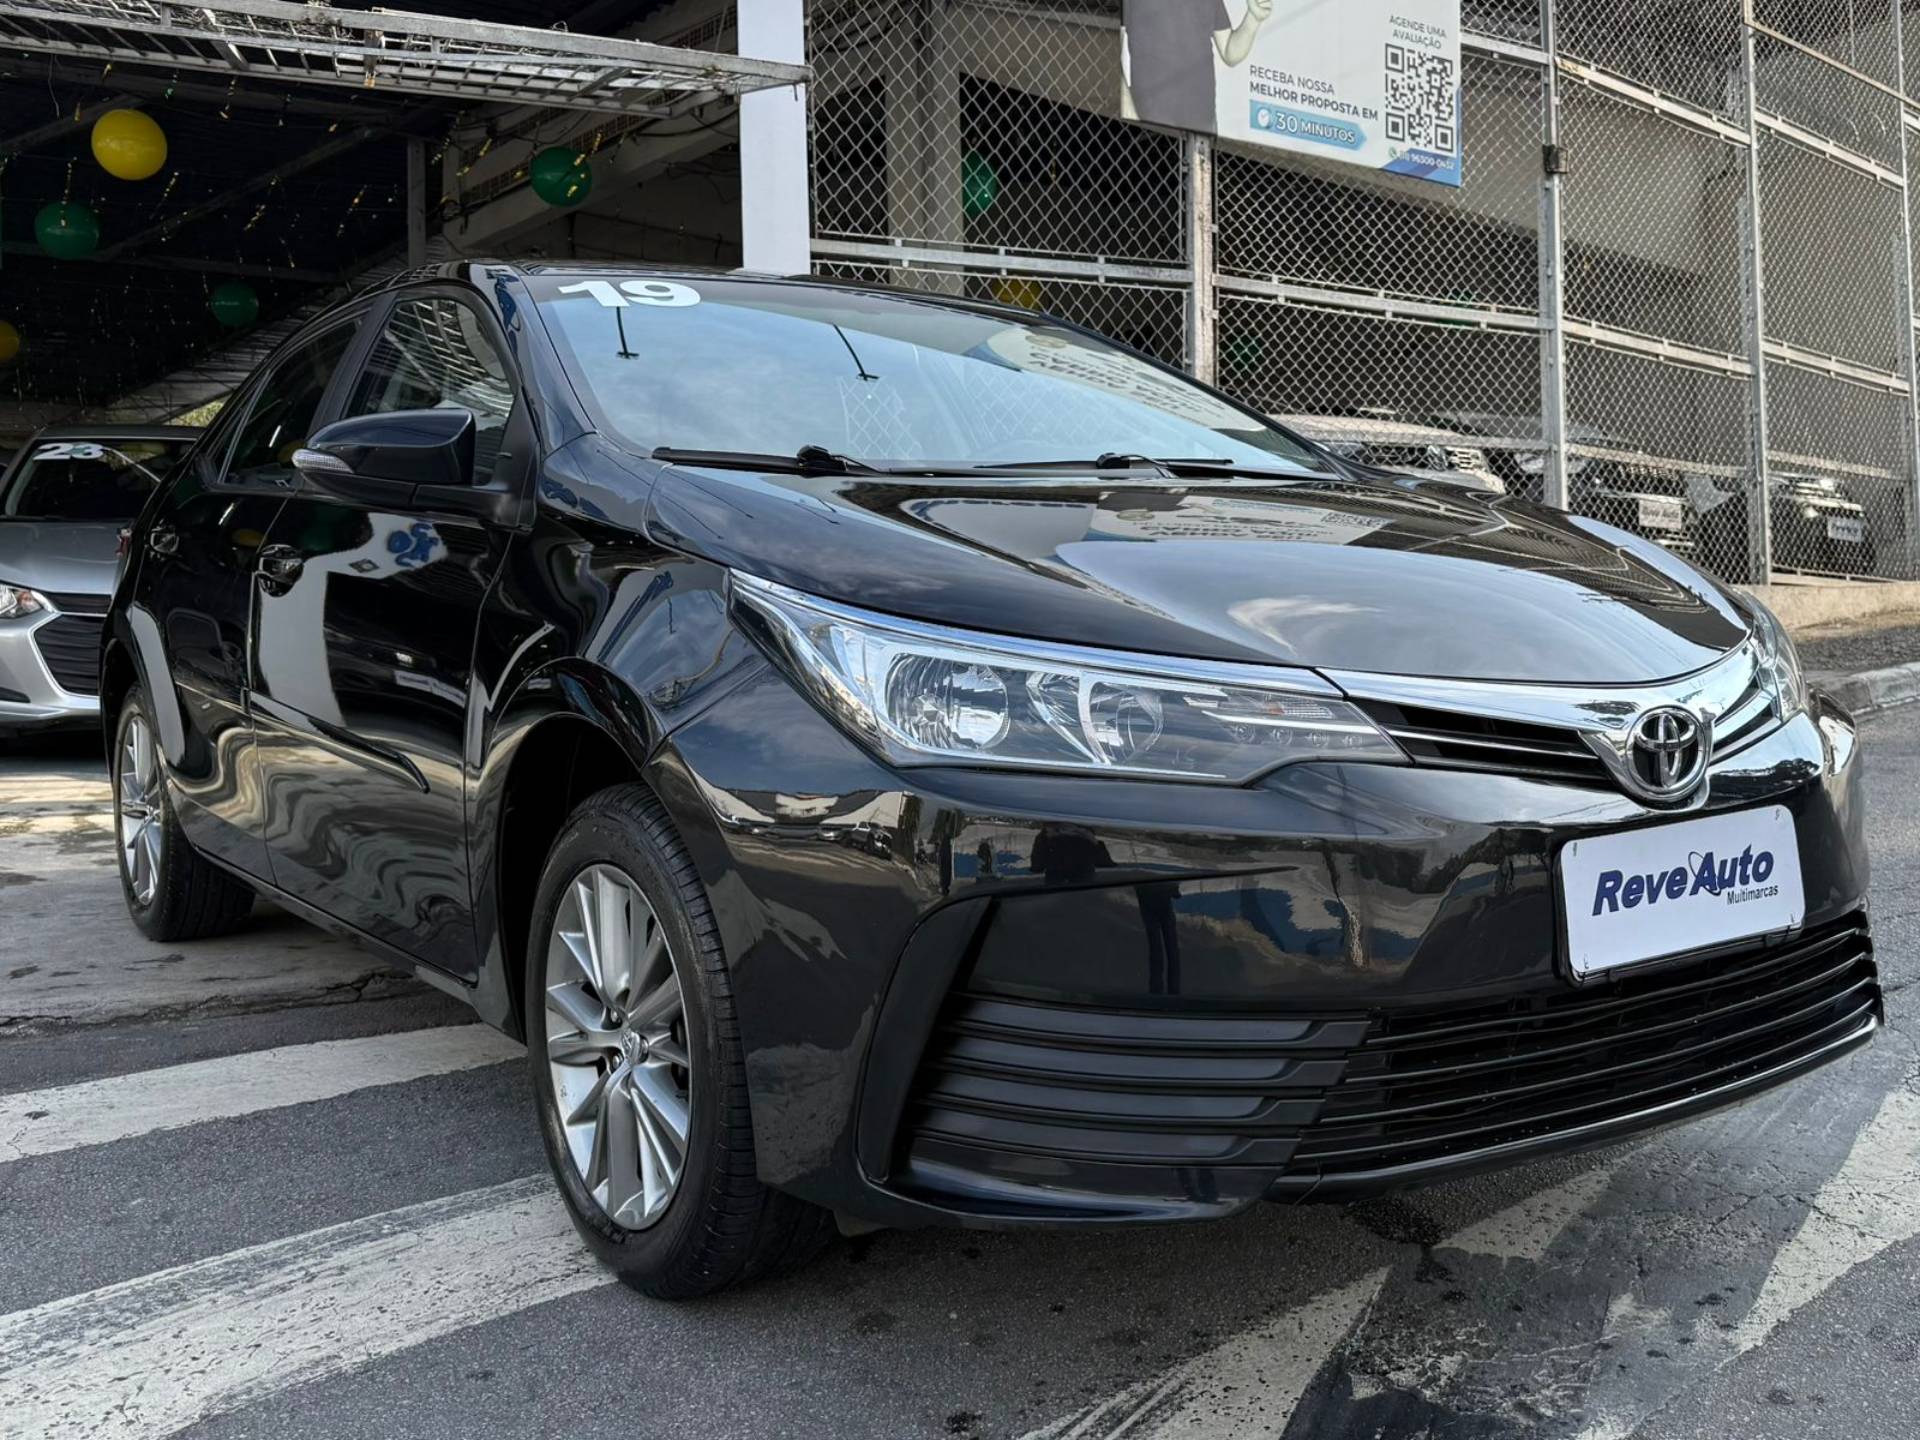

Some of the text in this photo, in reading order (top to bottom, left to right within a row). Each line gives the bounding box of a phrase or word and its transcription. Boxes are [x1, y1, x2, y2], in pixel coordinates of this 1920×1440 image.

[1389, 15, 1447, 39] AGENDE UMA
[1393, 29, 1442, 49] AVALIAÇÃO
[1249, 65, 1335, 96] RECEBA NOSSA
[1249, 81, 1379, 121] MELHOR PROPOSTA EM
[1275, 112, 1356, 143] 30 MINUTOS
[558, 280, 701, 308] 19
[1727, 884, 1779, 906] Multimarcas
